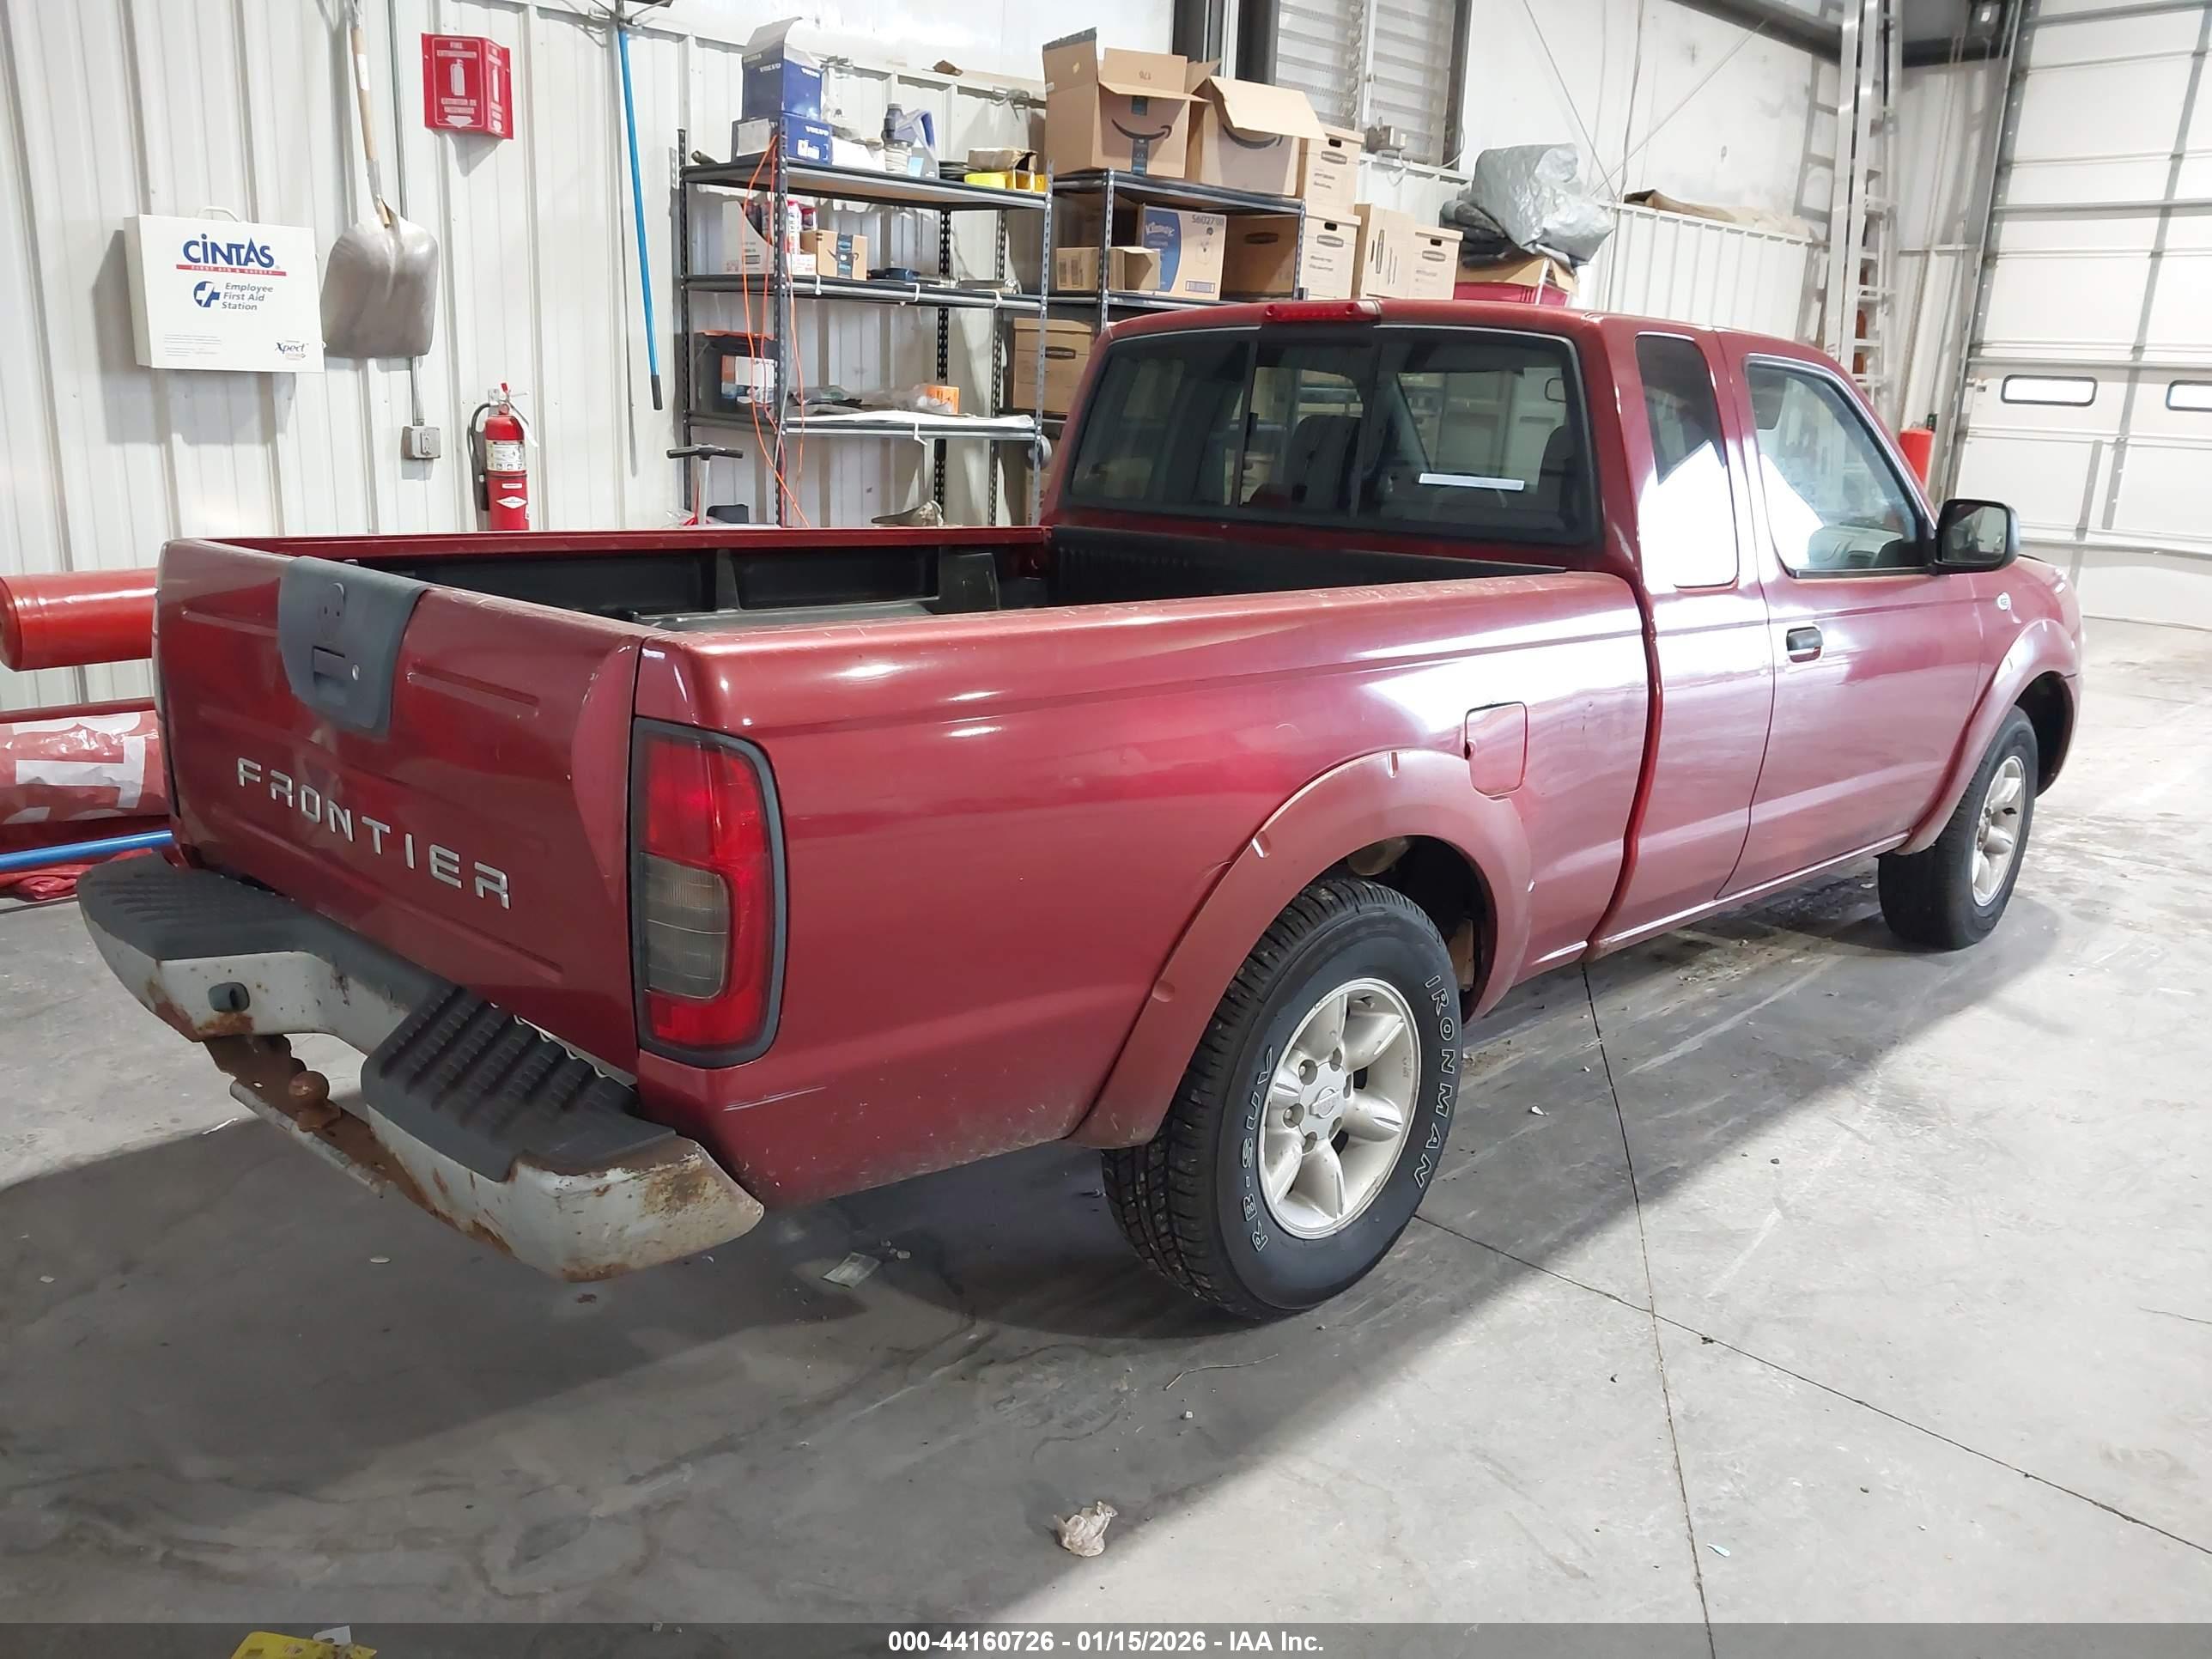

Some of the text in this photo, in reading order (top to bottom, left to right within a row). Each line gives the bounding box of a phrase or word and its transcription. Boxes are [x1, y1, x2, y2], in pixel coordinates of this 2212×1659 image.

[224, 282, 274, 295] Employee
[222, 291, 265, 302] First Aid
[222, 301, 258, 311] Station
[275, 341, 305, 354] Xpect
[236, 757, 511, 910] FRONTIER
[1413, 975, 1455, 1189] IRONMAN
[1242, 1046, 1273, 1253] RB-SUV
